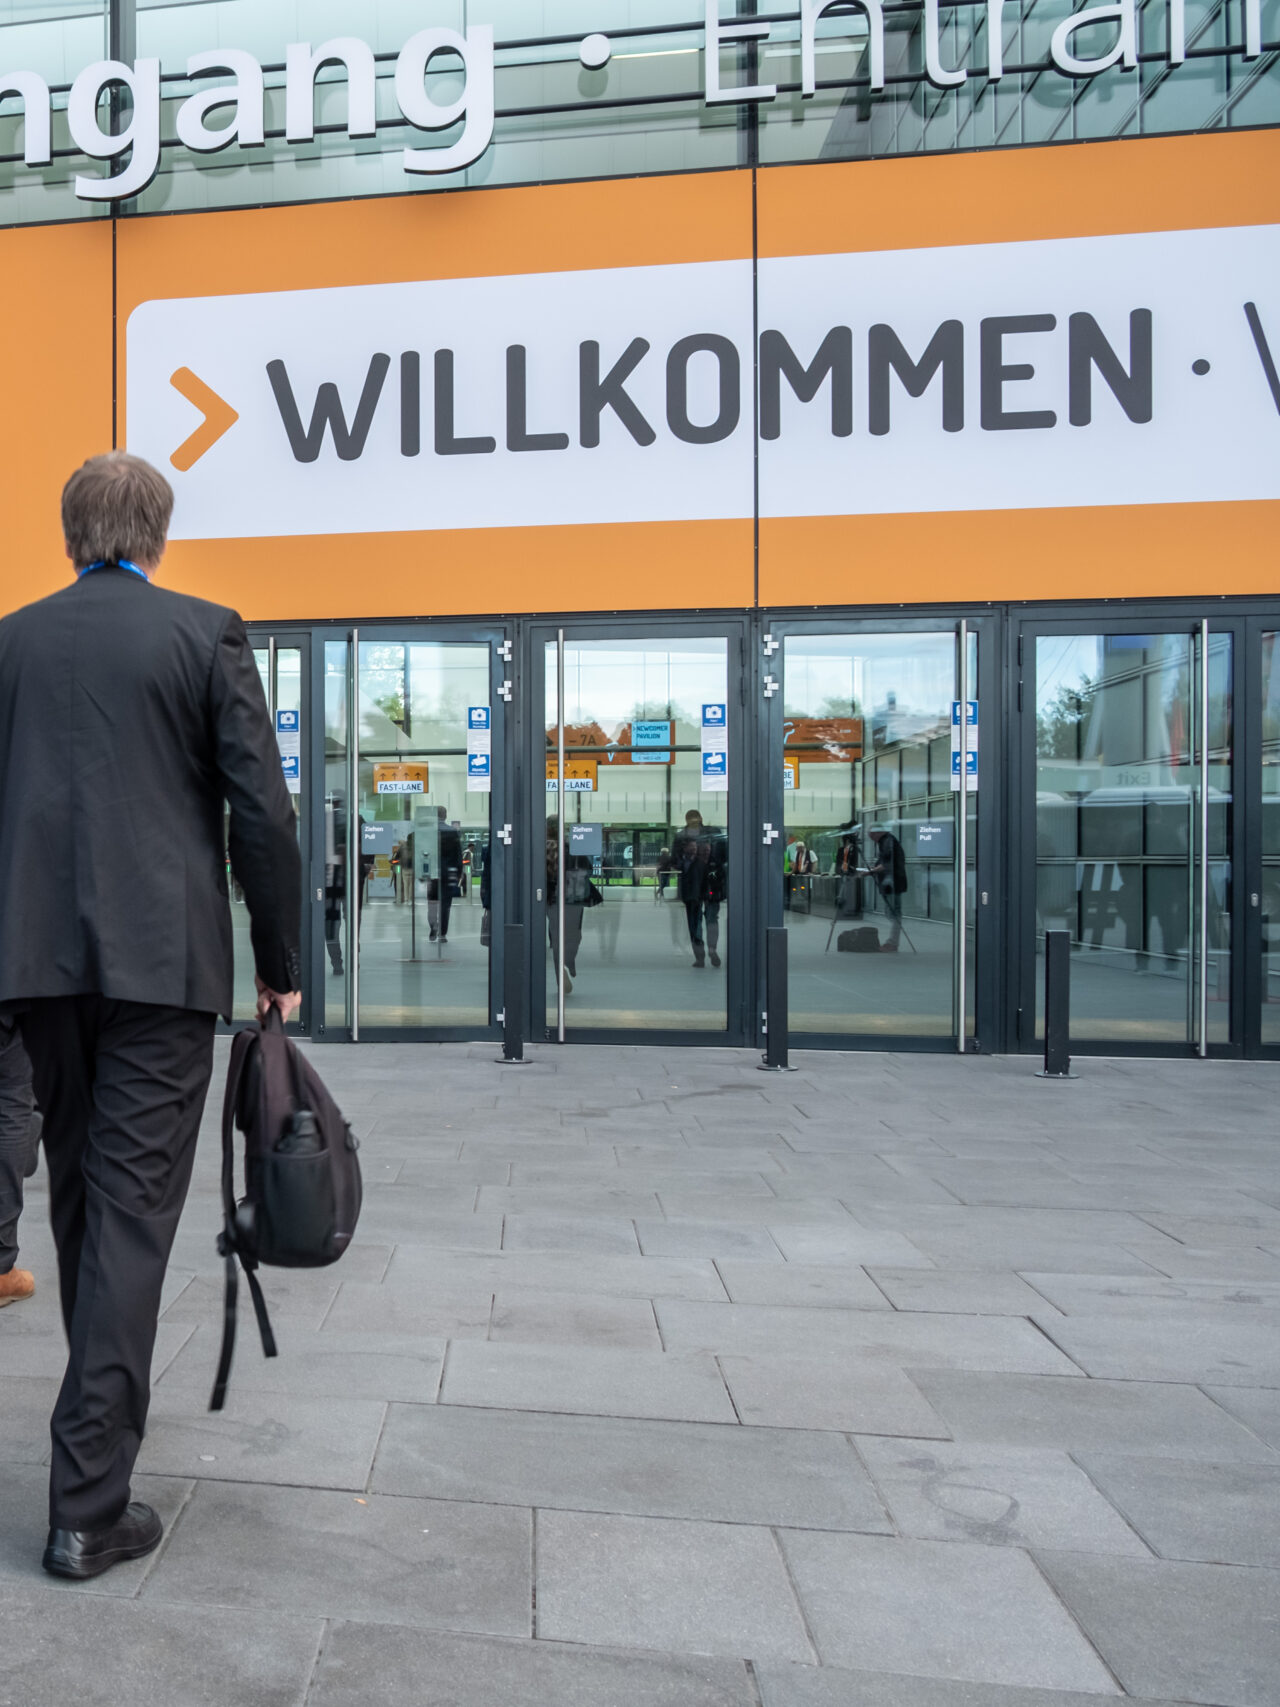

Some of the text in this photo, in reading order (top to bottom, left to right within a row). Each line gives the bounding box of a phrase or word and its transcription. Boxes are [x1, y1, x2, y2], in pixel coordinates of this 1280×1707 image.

[266, 308, 1153, 464] WILLKOMMEN
[379, 783, 422, 792] FAST-LANE
[547, 781, 591, 790] FA-LANE
